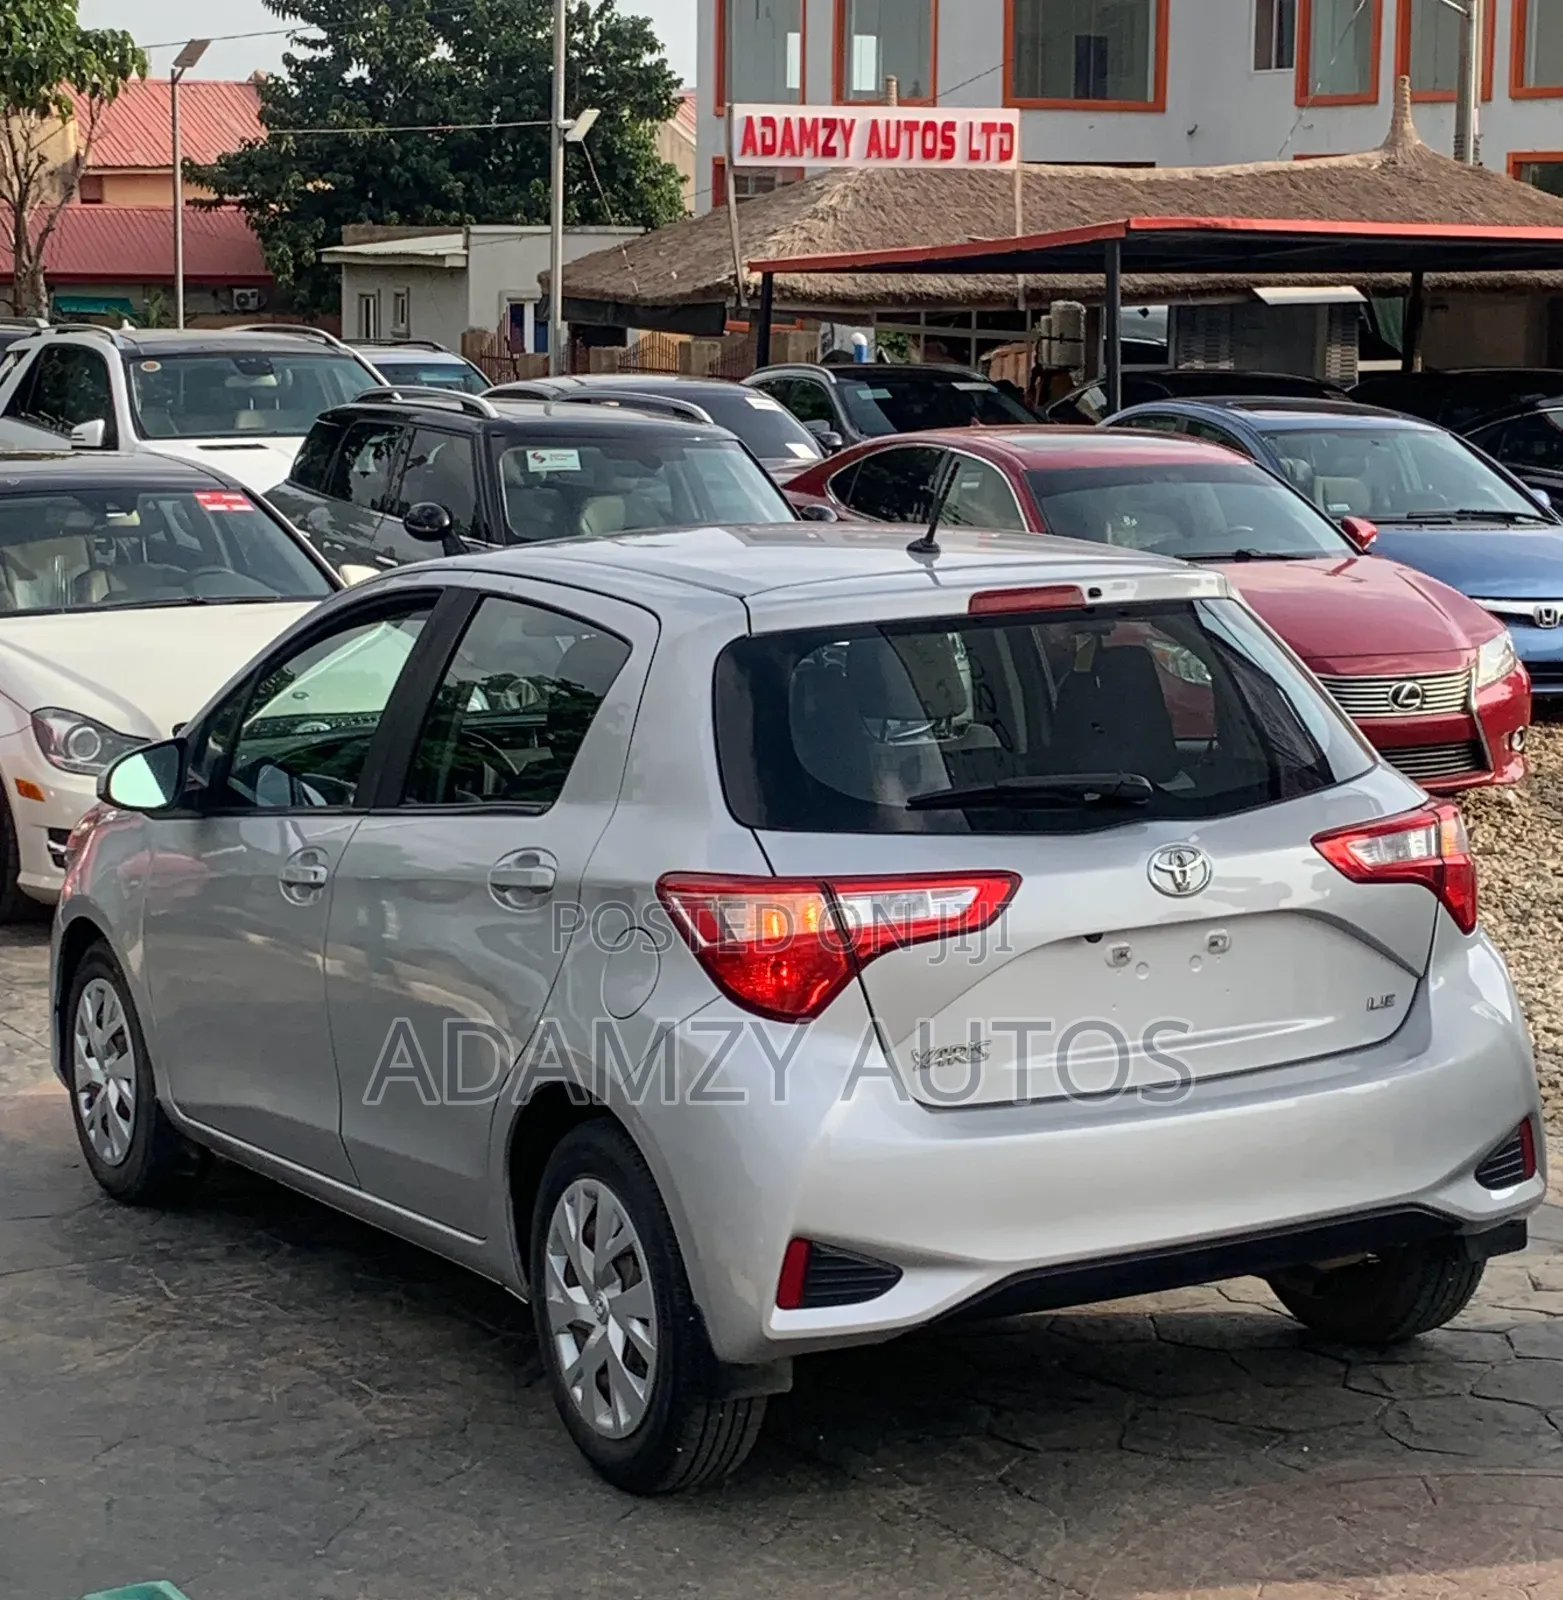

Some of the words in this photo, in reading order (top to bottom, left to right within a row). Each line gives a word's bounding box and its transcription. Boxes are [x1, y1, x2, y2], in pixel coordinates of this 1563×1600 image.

[740, 115, 856, 158] ADAMZY
[865, 118, 957, 161] AUTOS
[967, 120, 1015, 162] LTD
[1366, 993, 1396, 1012] LE
